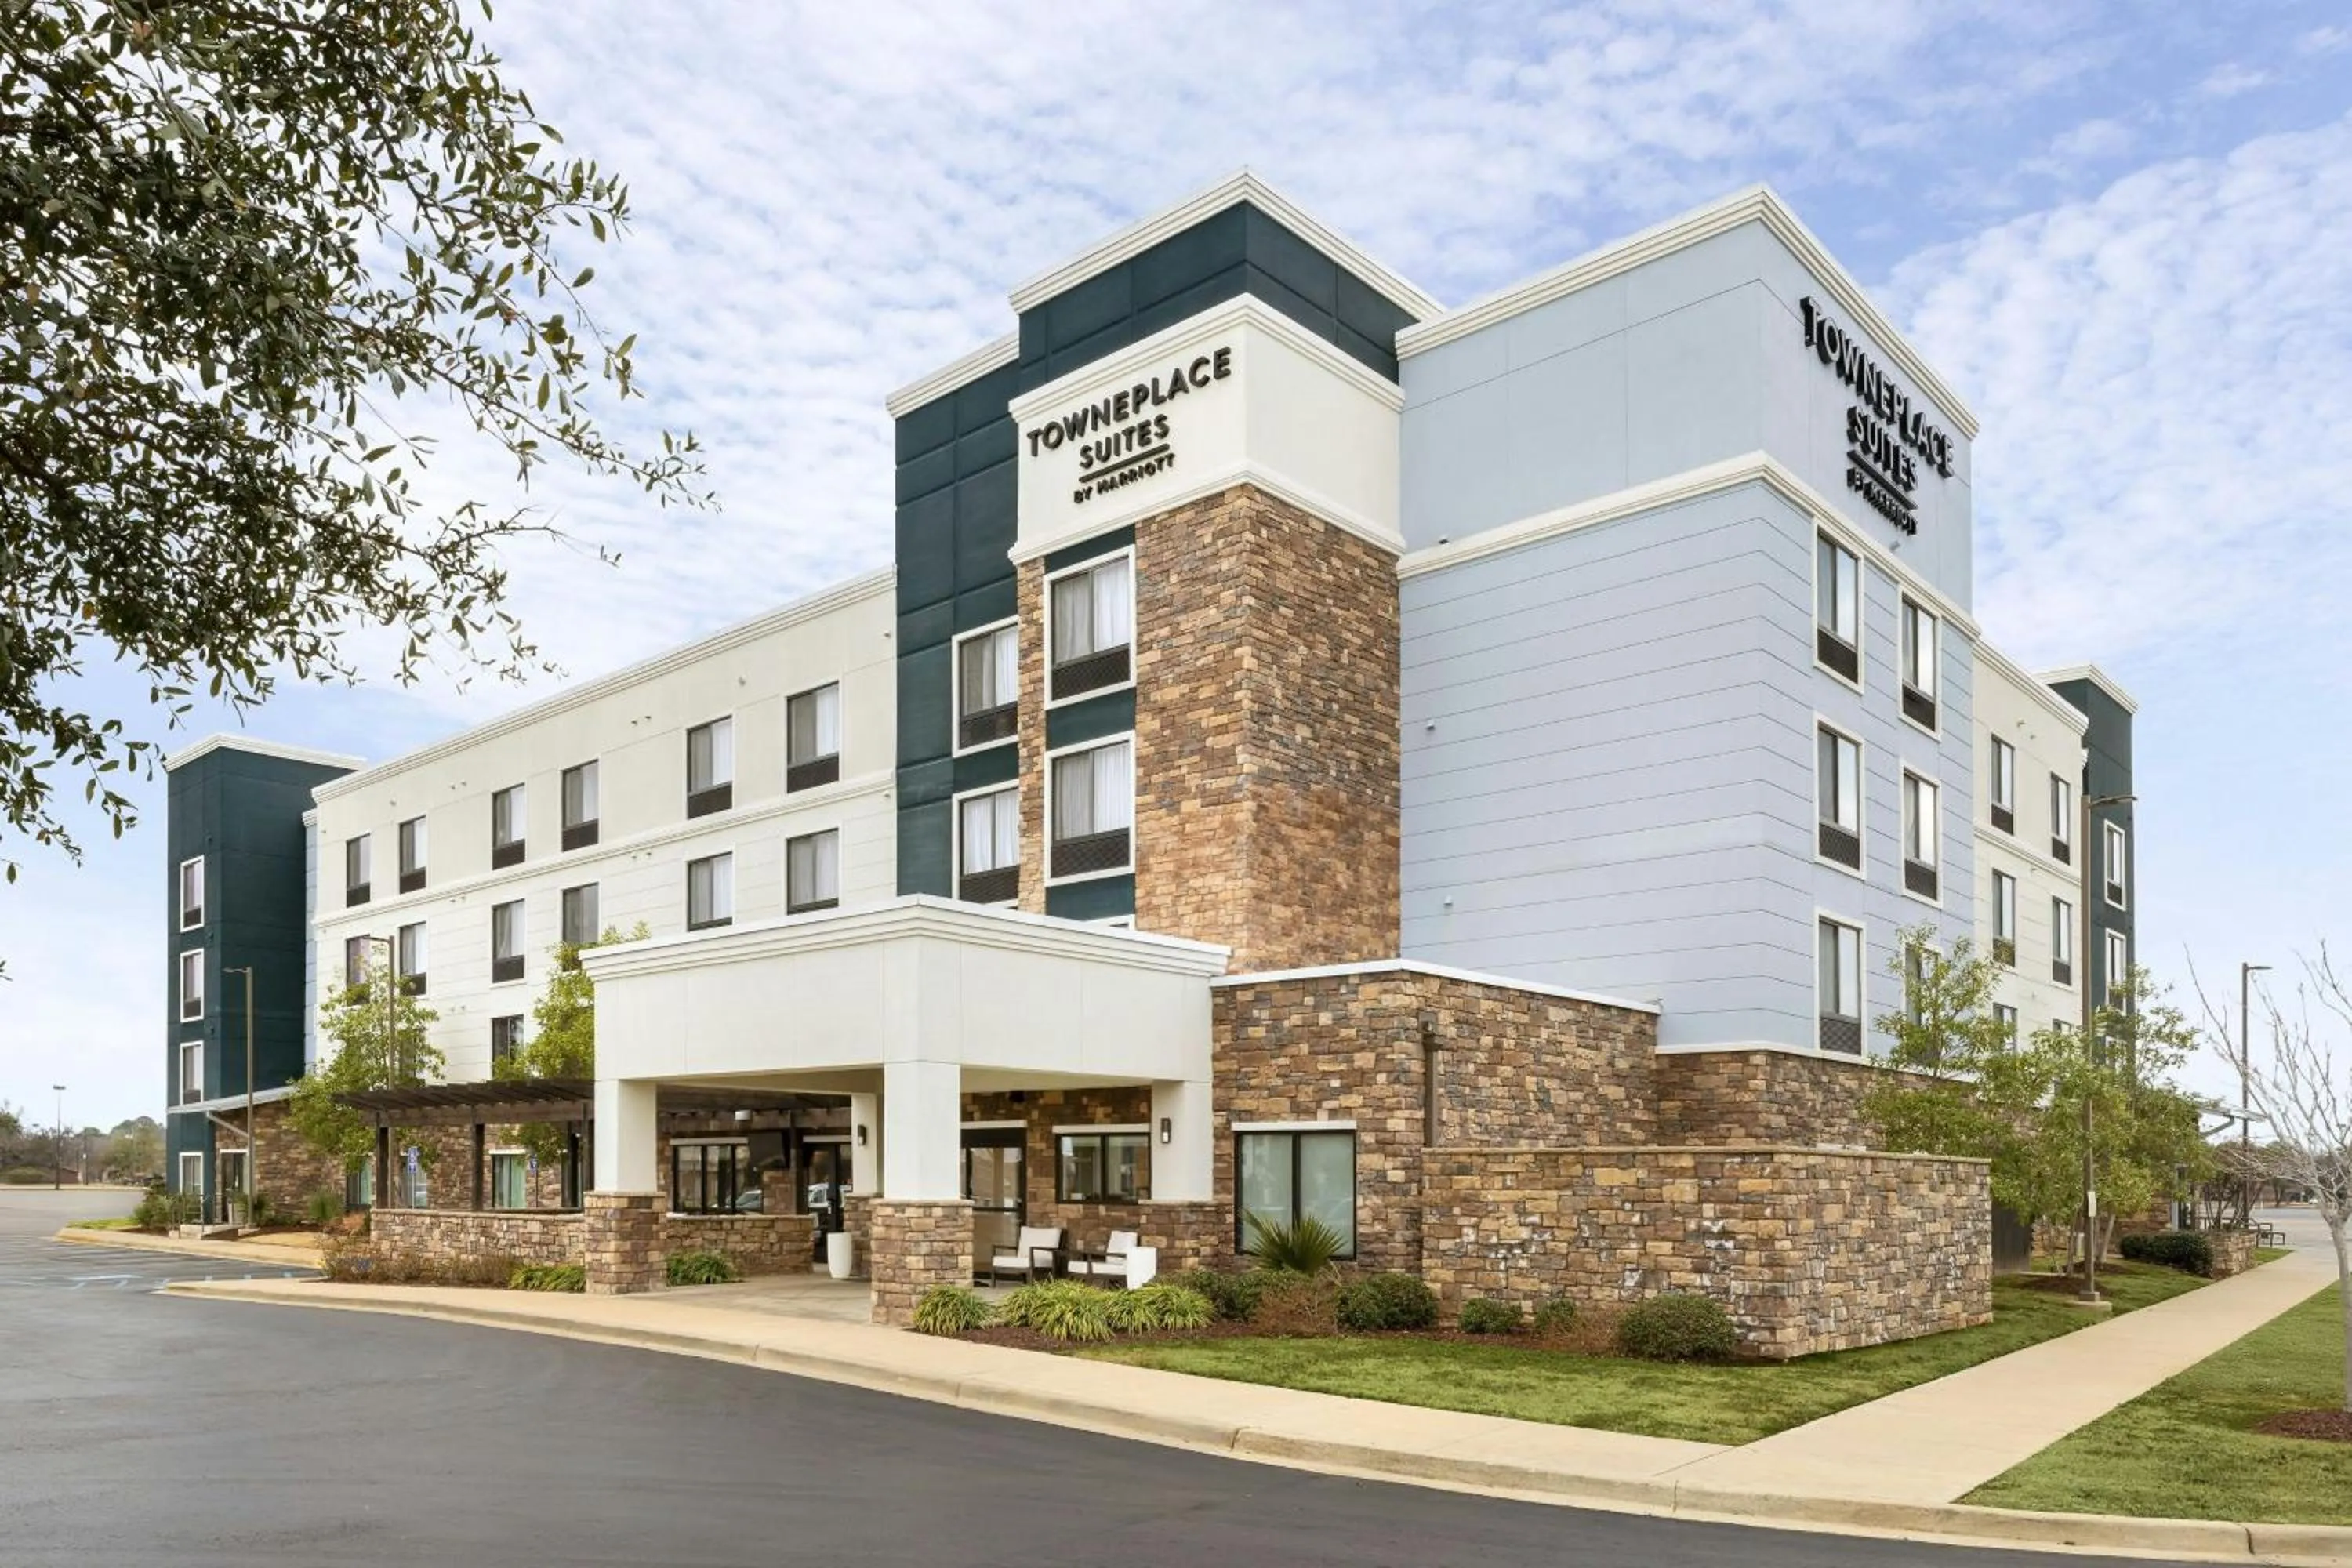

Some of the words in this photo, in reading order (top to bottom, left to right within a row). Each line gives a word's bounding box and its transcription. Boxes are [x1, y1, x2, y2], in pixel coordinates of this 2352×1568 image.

[1027, 347, 1231, 457] TOWNEPLACE
[1800, 296, 1954, 479] TOWNEPLACE
[1074, 486, 1093, 503] BY
[1097, 453, 1175, 495] MARRIOTT
[1080, 414, 1170, 469] SUITES
[1846, 405, 1918, 492] SUITES
